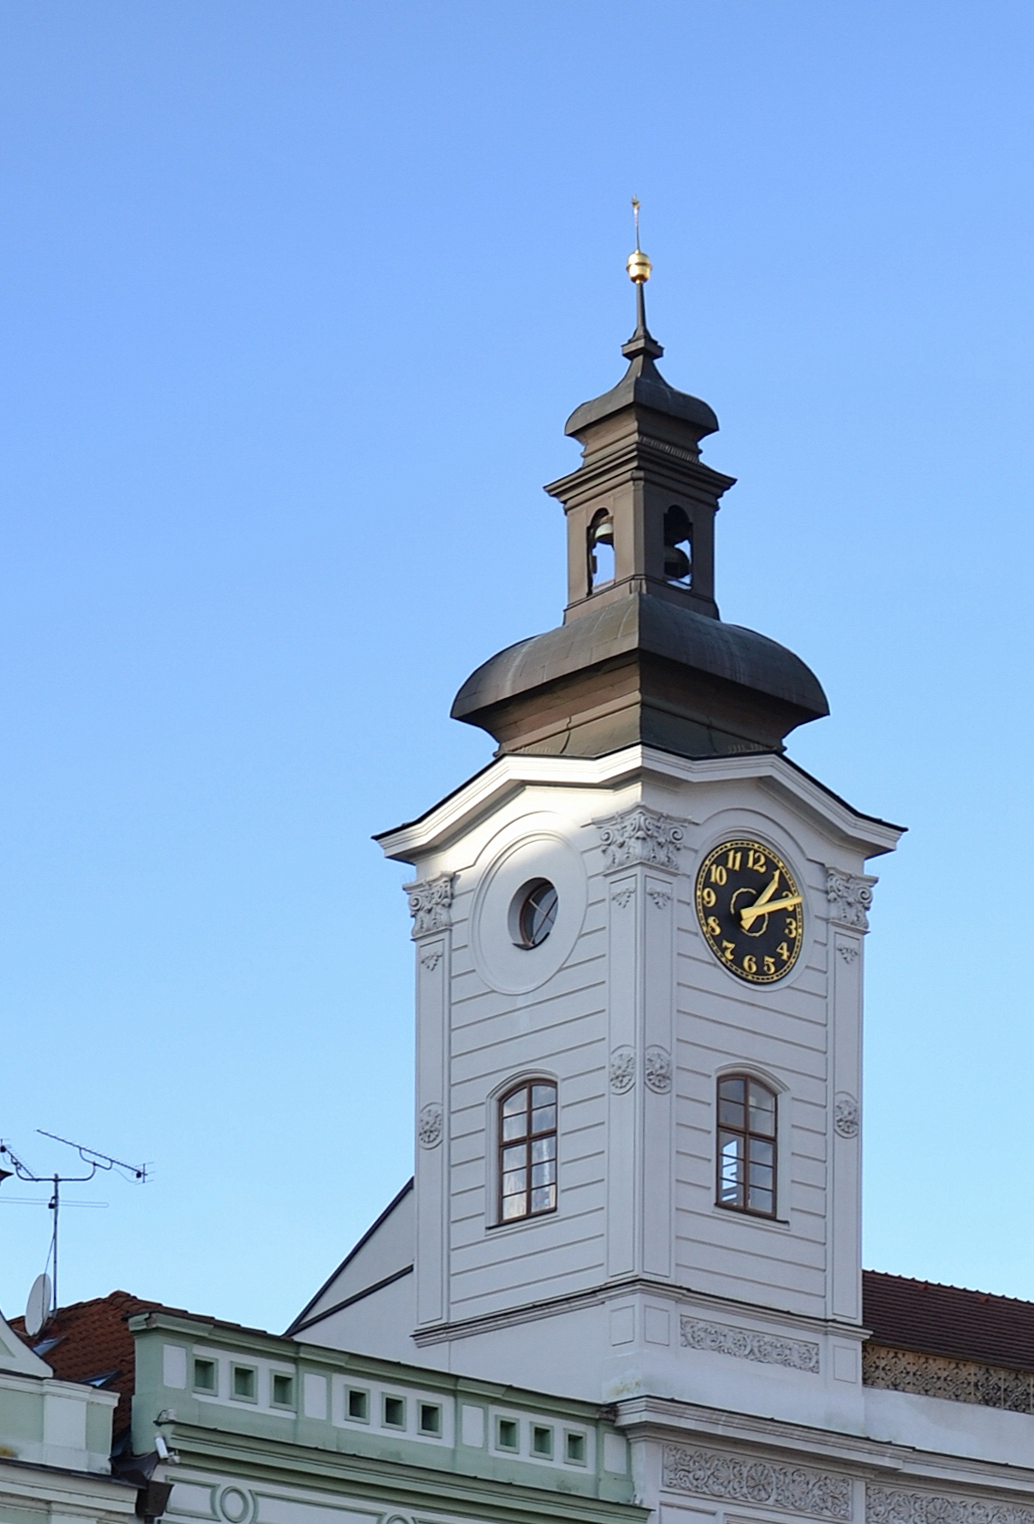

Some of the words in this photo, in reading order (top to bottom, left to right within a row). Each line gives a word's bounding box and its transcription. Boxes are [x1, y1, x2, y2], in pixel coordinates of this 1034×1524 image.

[727, 850, 742, 871] 11
[747, 849, 766, 873] 12
[710, 864, 727, 885] 10
[702, 888, 717, 907] 9
[707, 916, 721, 936] 8
[785, 918, 797, 938] 3
[722, 939, 735, 960] 7
[776, 942, 790, 961] 4
[743, 955, 757, 973] 6
[764, 956, 776, 975] 5
